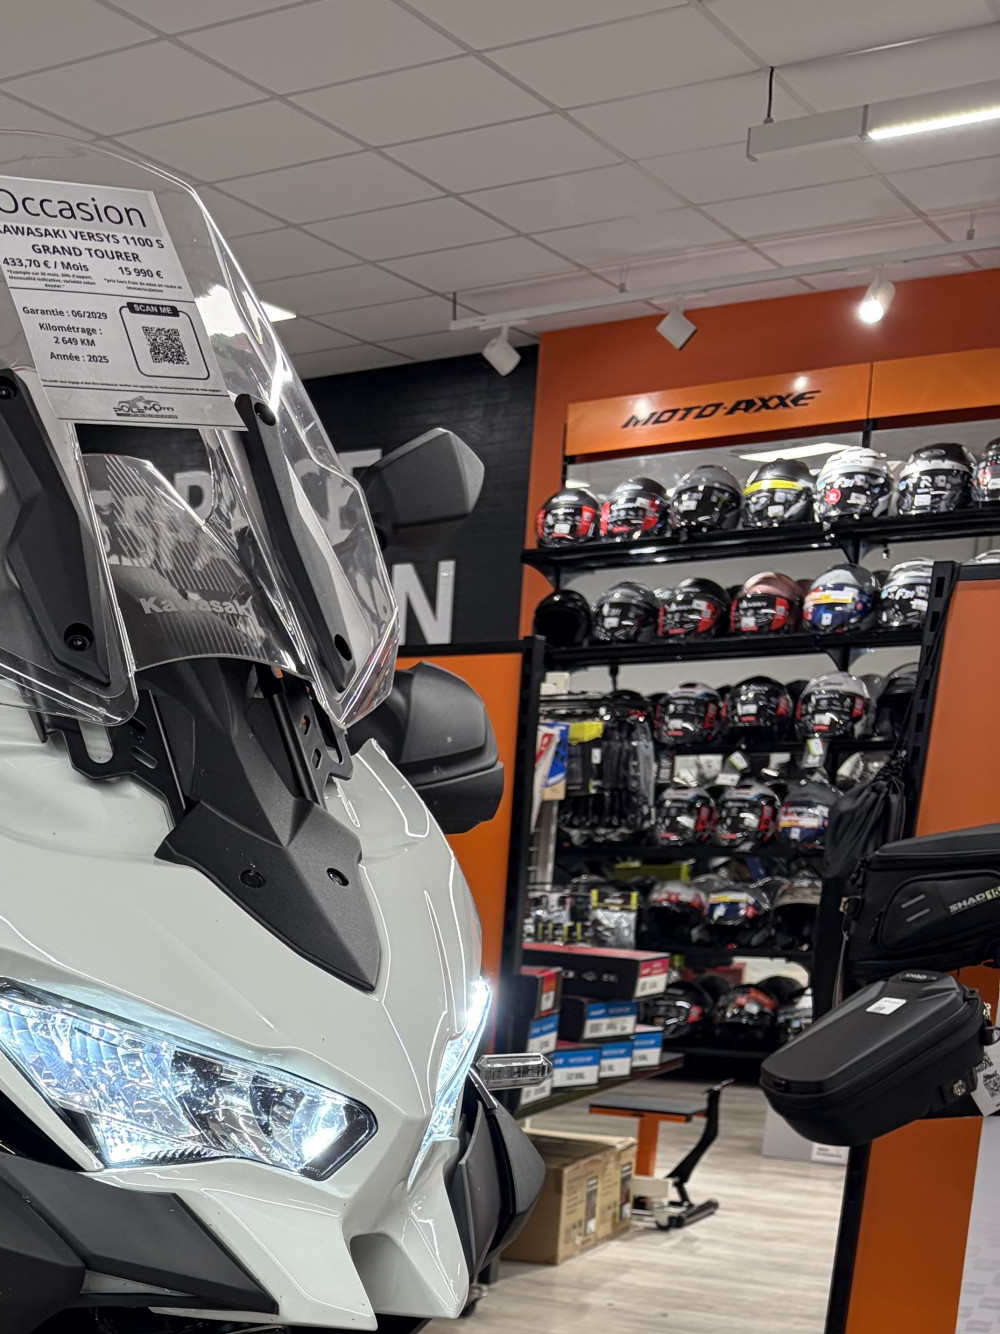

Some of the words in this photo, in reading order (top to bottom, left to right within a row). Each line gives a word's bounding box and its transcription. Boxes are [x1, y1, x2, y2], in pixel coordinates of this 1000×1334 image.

[69, 229, 120, 244] VERSYS
[123, 235, 153, 248] 1100
[156, 239, 164, 248] S
[31, 244, 83, 257] GRAND
[85, 248, 141, 263] TOURER
[3, 257, 41, 268] 433,70
[43, 260, 51, 269] €
[60, 261, 89, 272] Mois
[118, 267, 132, 275] 15
[133, 267, 154, 278] 990
[156, 270, 163, 279] €
[22, 306, 65, 317] Garantie
[71, 310, 108, 320] 06/2029
[133, 303, 159, 313] SCAN
[160, 306, 173, 314] ME
[38, 322, 97, 336] Kilométrage
[53, 336, 61, 344] 2
[61, 336, 78, 346] 649
[80, 338, 96, 347] KM
[50, 351, 81, 362] Année
[88, 355, 109, 364] 2025
[949, 893, 986, 914] SHAD
